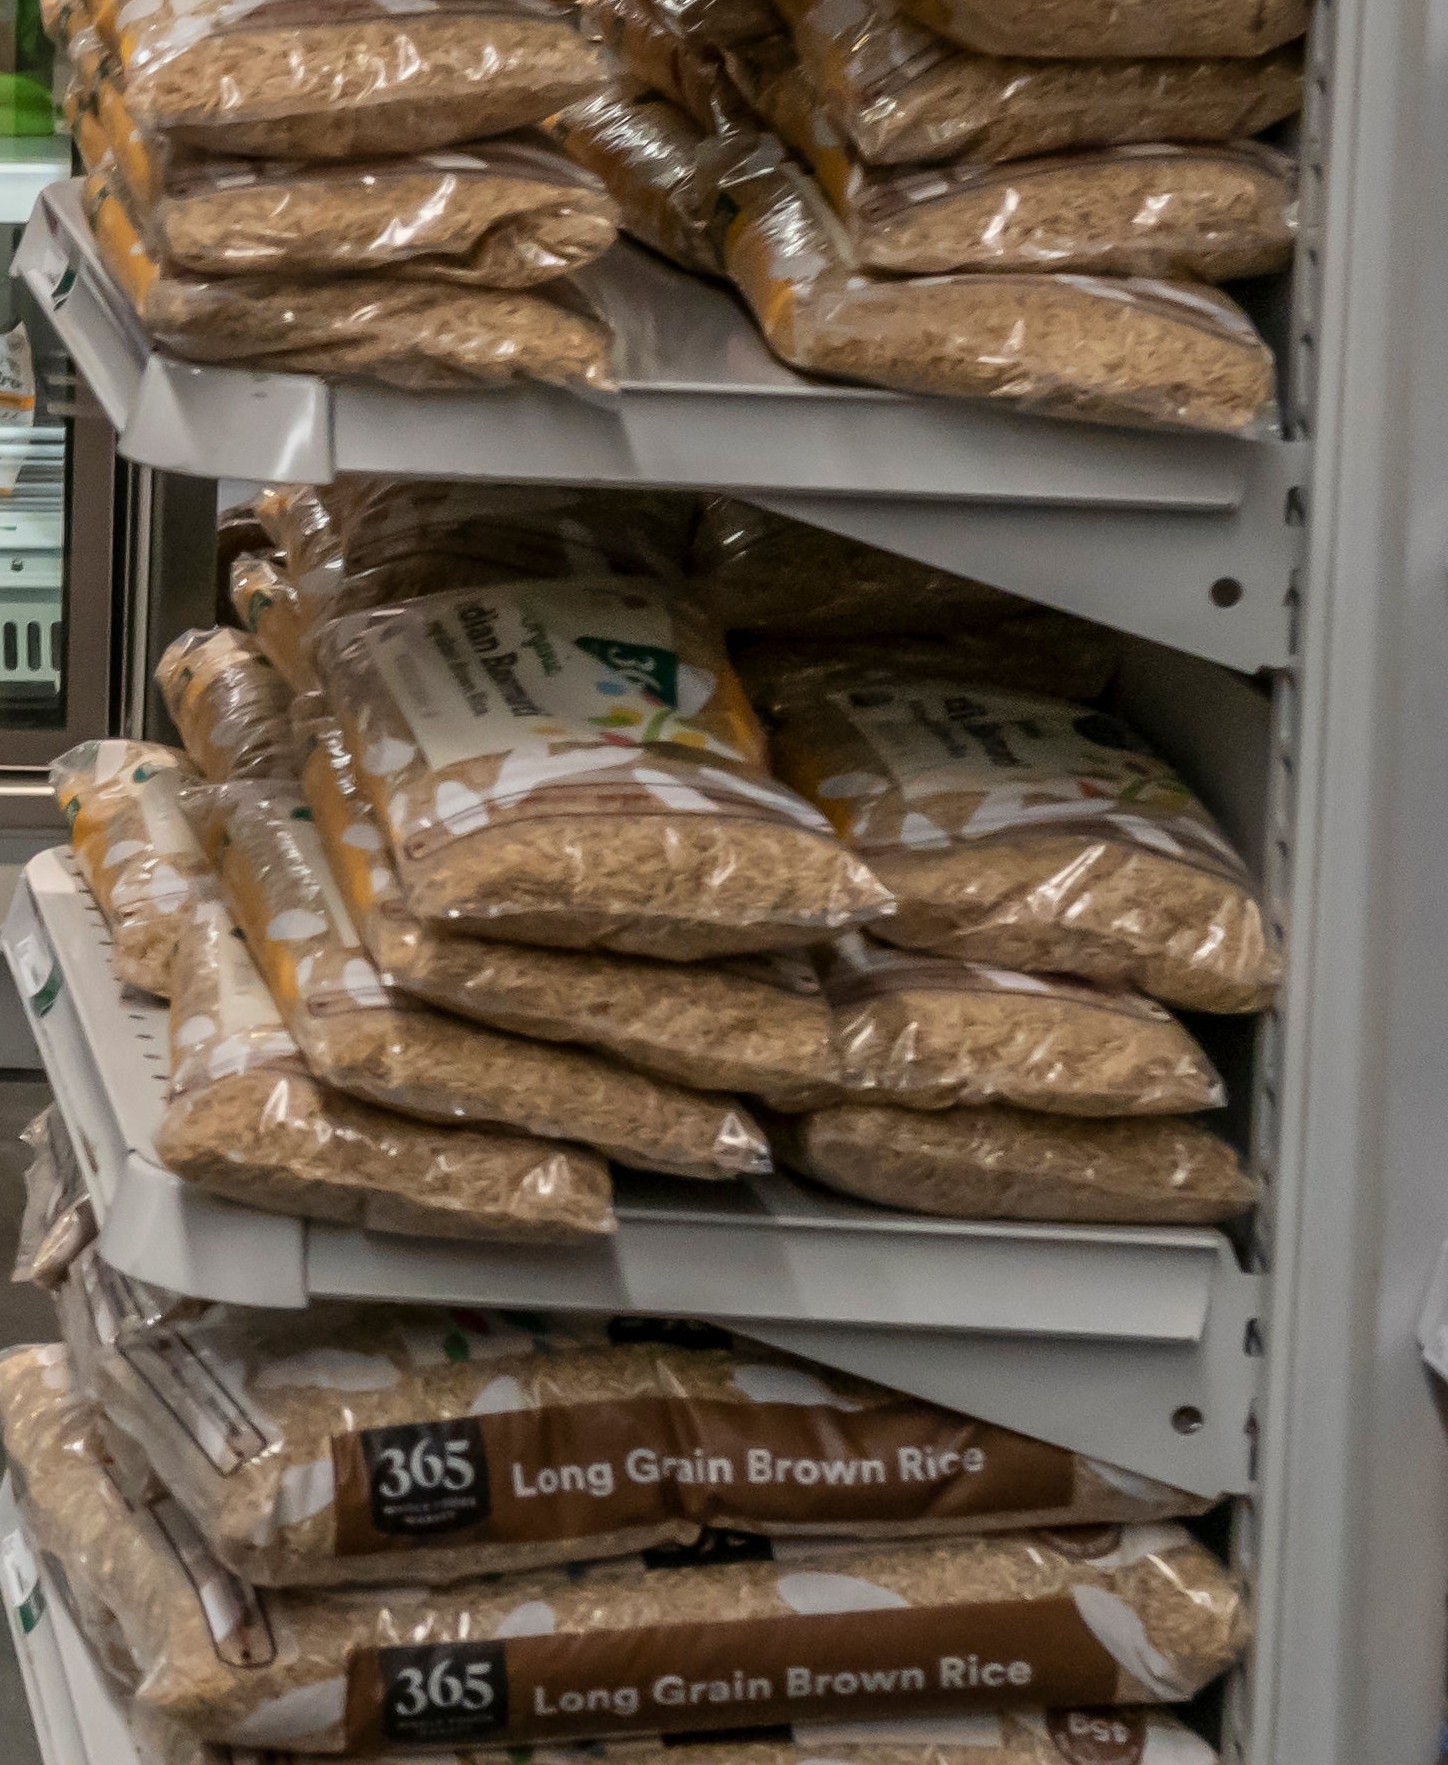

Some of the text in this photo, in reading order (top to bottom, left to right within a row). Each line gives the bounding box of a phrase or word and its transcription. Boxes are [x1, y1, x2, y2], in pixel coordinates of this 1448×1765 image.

[378, 1438, 476, 1499] 365
[511, 1441, 987, 1499] Long Grain Brown Rice
[394, 1658, 495, 1717] 365
[532, 1655, 1034, 1717] Long Grain Brown Rice
